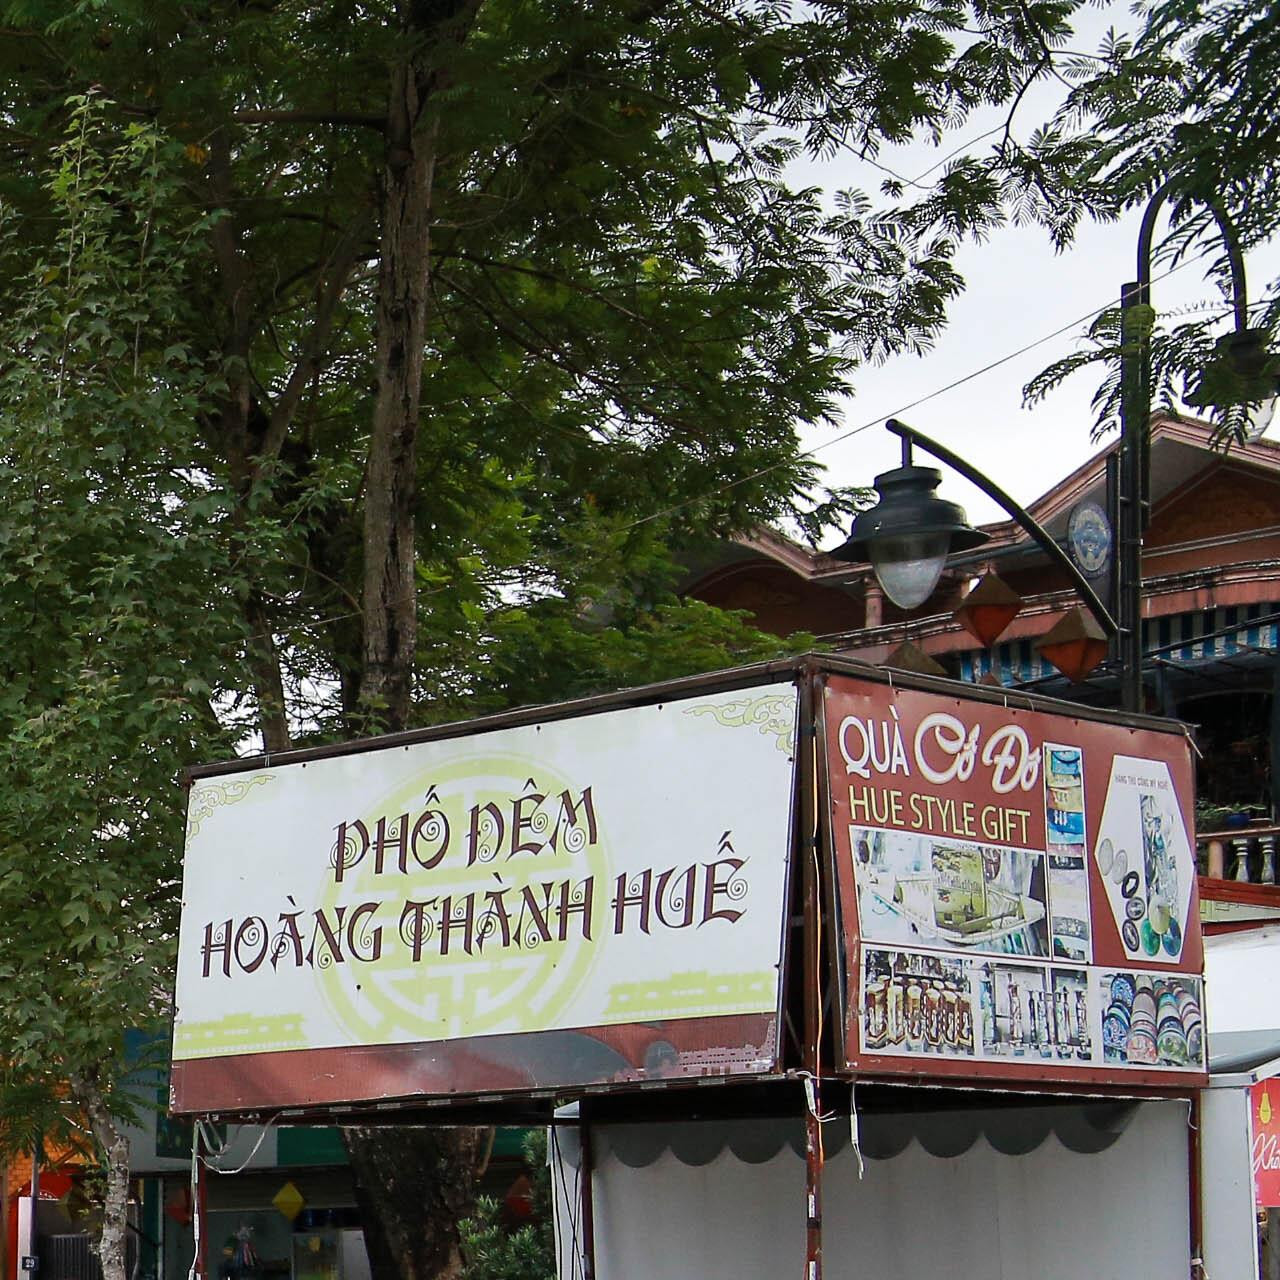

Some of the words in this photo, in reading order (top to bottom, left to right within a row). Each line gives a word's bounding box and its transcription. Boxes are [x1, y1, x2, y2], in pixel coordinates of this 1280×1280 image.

[838, 704, 910, 779] QUÀ
[329, 784, 451, 882] PHỐ
[465, 778, 599, 868] ĐÊM
[848, 785, 905, 826] HUE
[909, 792, 977, 837] STYLE
[980, 805, 1031, 844] GIFT
[200, 895, 383, 978] HOÀNG
[397, 871, 595, 962] THÀNH
[610, 831, 748, 935] HUẾ
